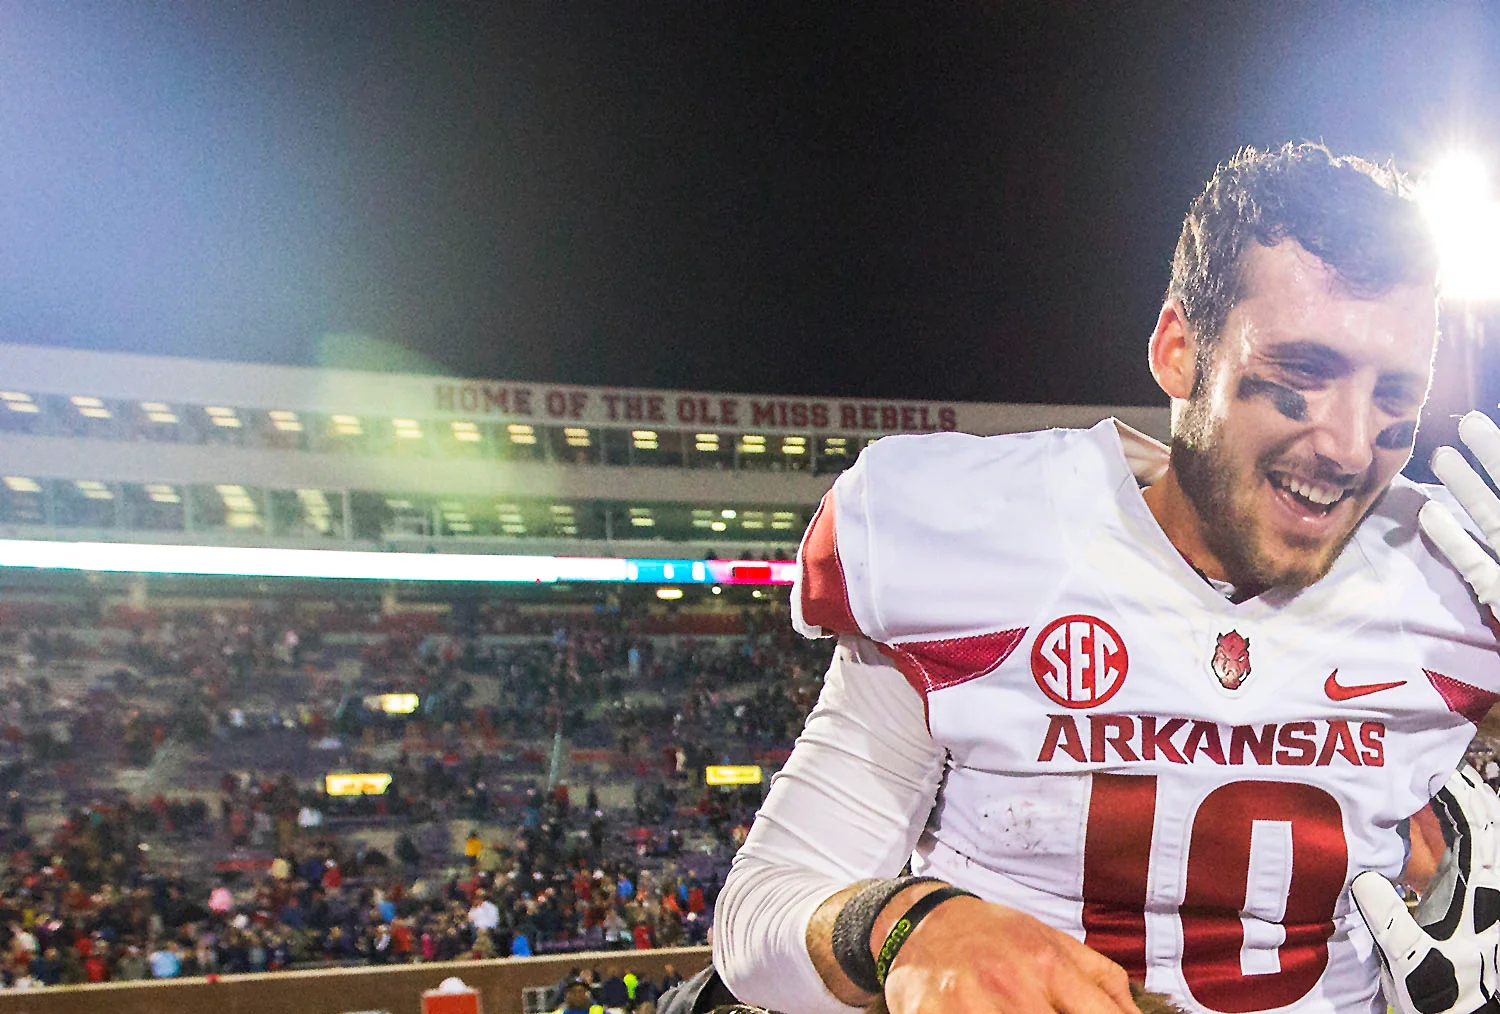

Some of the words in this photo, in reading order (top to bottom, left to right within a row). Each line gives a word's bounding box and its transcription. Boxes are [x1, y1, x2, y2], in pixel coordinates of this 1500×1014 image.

[434, 384, 534, 416] HOME
[546, 390, 589, 419] OF
[602, 394, 666, 422] THE
[676, 396, 739, 425] OLE
[751, 401, 830, 427] MISS
[839, 405, 958, 432] REBELS
[1038, 620, 1120, 703] SEC
[1036, 713, 1387, 768] ARKANSAS
[1082, 772, 1349, 1014] 10
